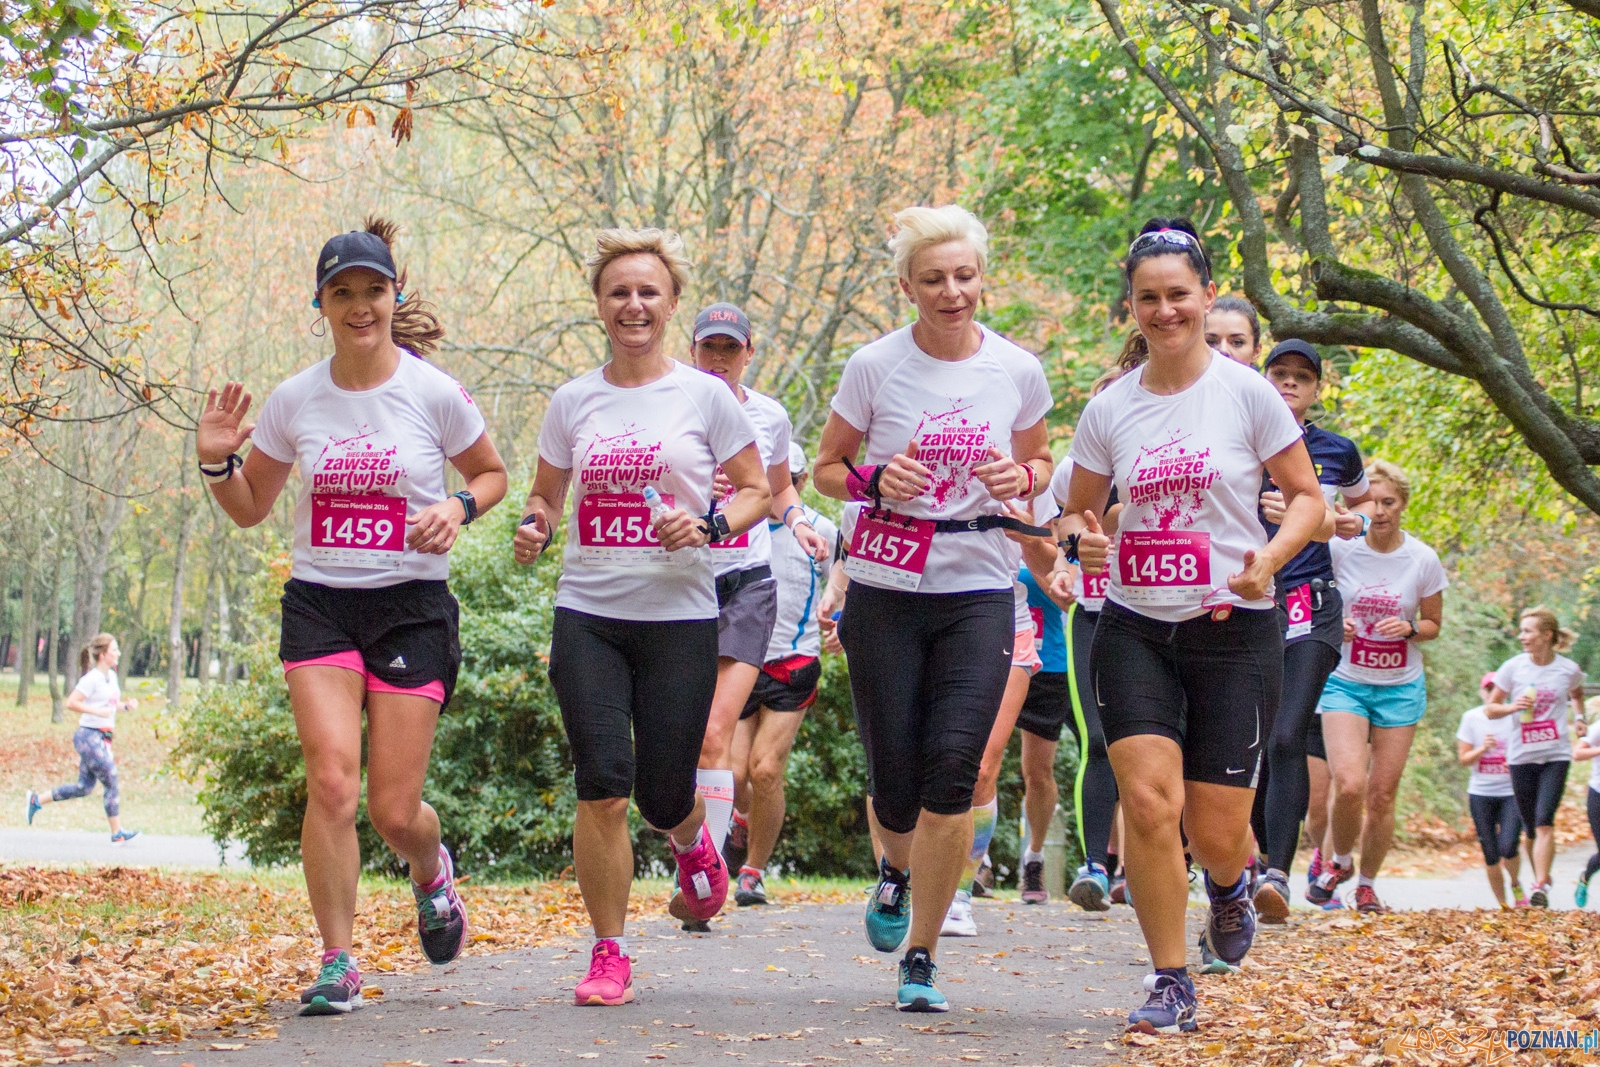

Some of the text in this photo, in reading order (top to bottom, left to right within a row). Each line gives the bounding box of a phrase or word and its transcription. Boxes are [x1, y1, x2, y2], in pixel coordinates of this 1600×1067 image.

[920, 433, 985, 446] zawsze
[323, 458, 390, 471] zawsze
[589, 453, 654, 466] zawsze
[313, 470, 400, 491] pier(w)si!
[581, 465, 663, 486] pier(w)si!
[1137, 460, 1204, 482] zawsze
[587, 482, 608, 490] 2016
[1129, 472, 1214, 503] pier(w)si!
[1136, 493, 1160, 507] 2016
[321, 516, 394, 546] 1459
[856, 529, 920, 565] 1457
[1127, 553, 1198, 582] 1458
[1089, 577, 1110, 596] 19
[1357, 649, 1402, 667] 1500
